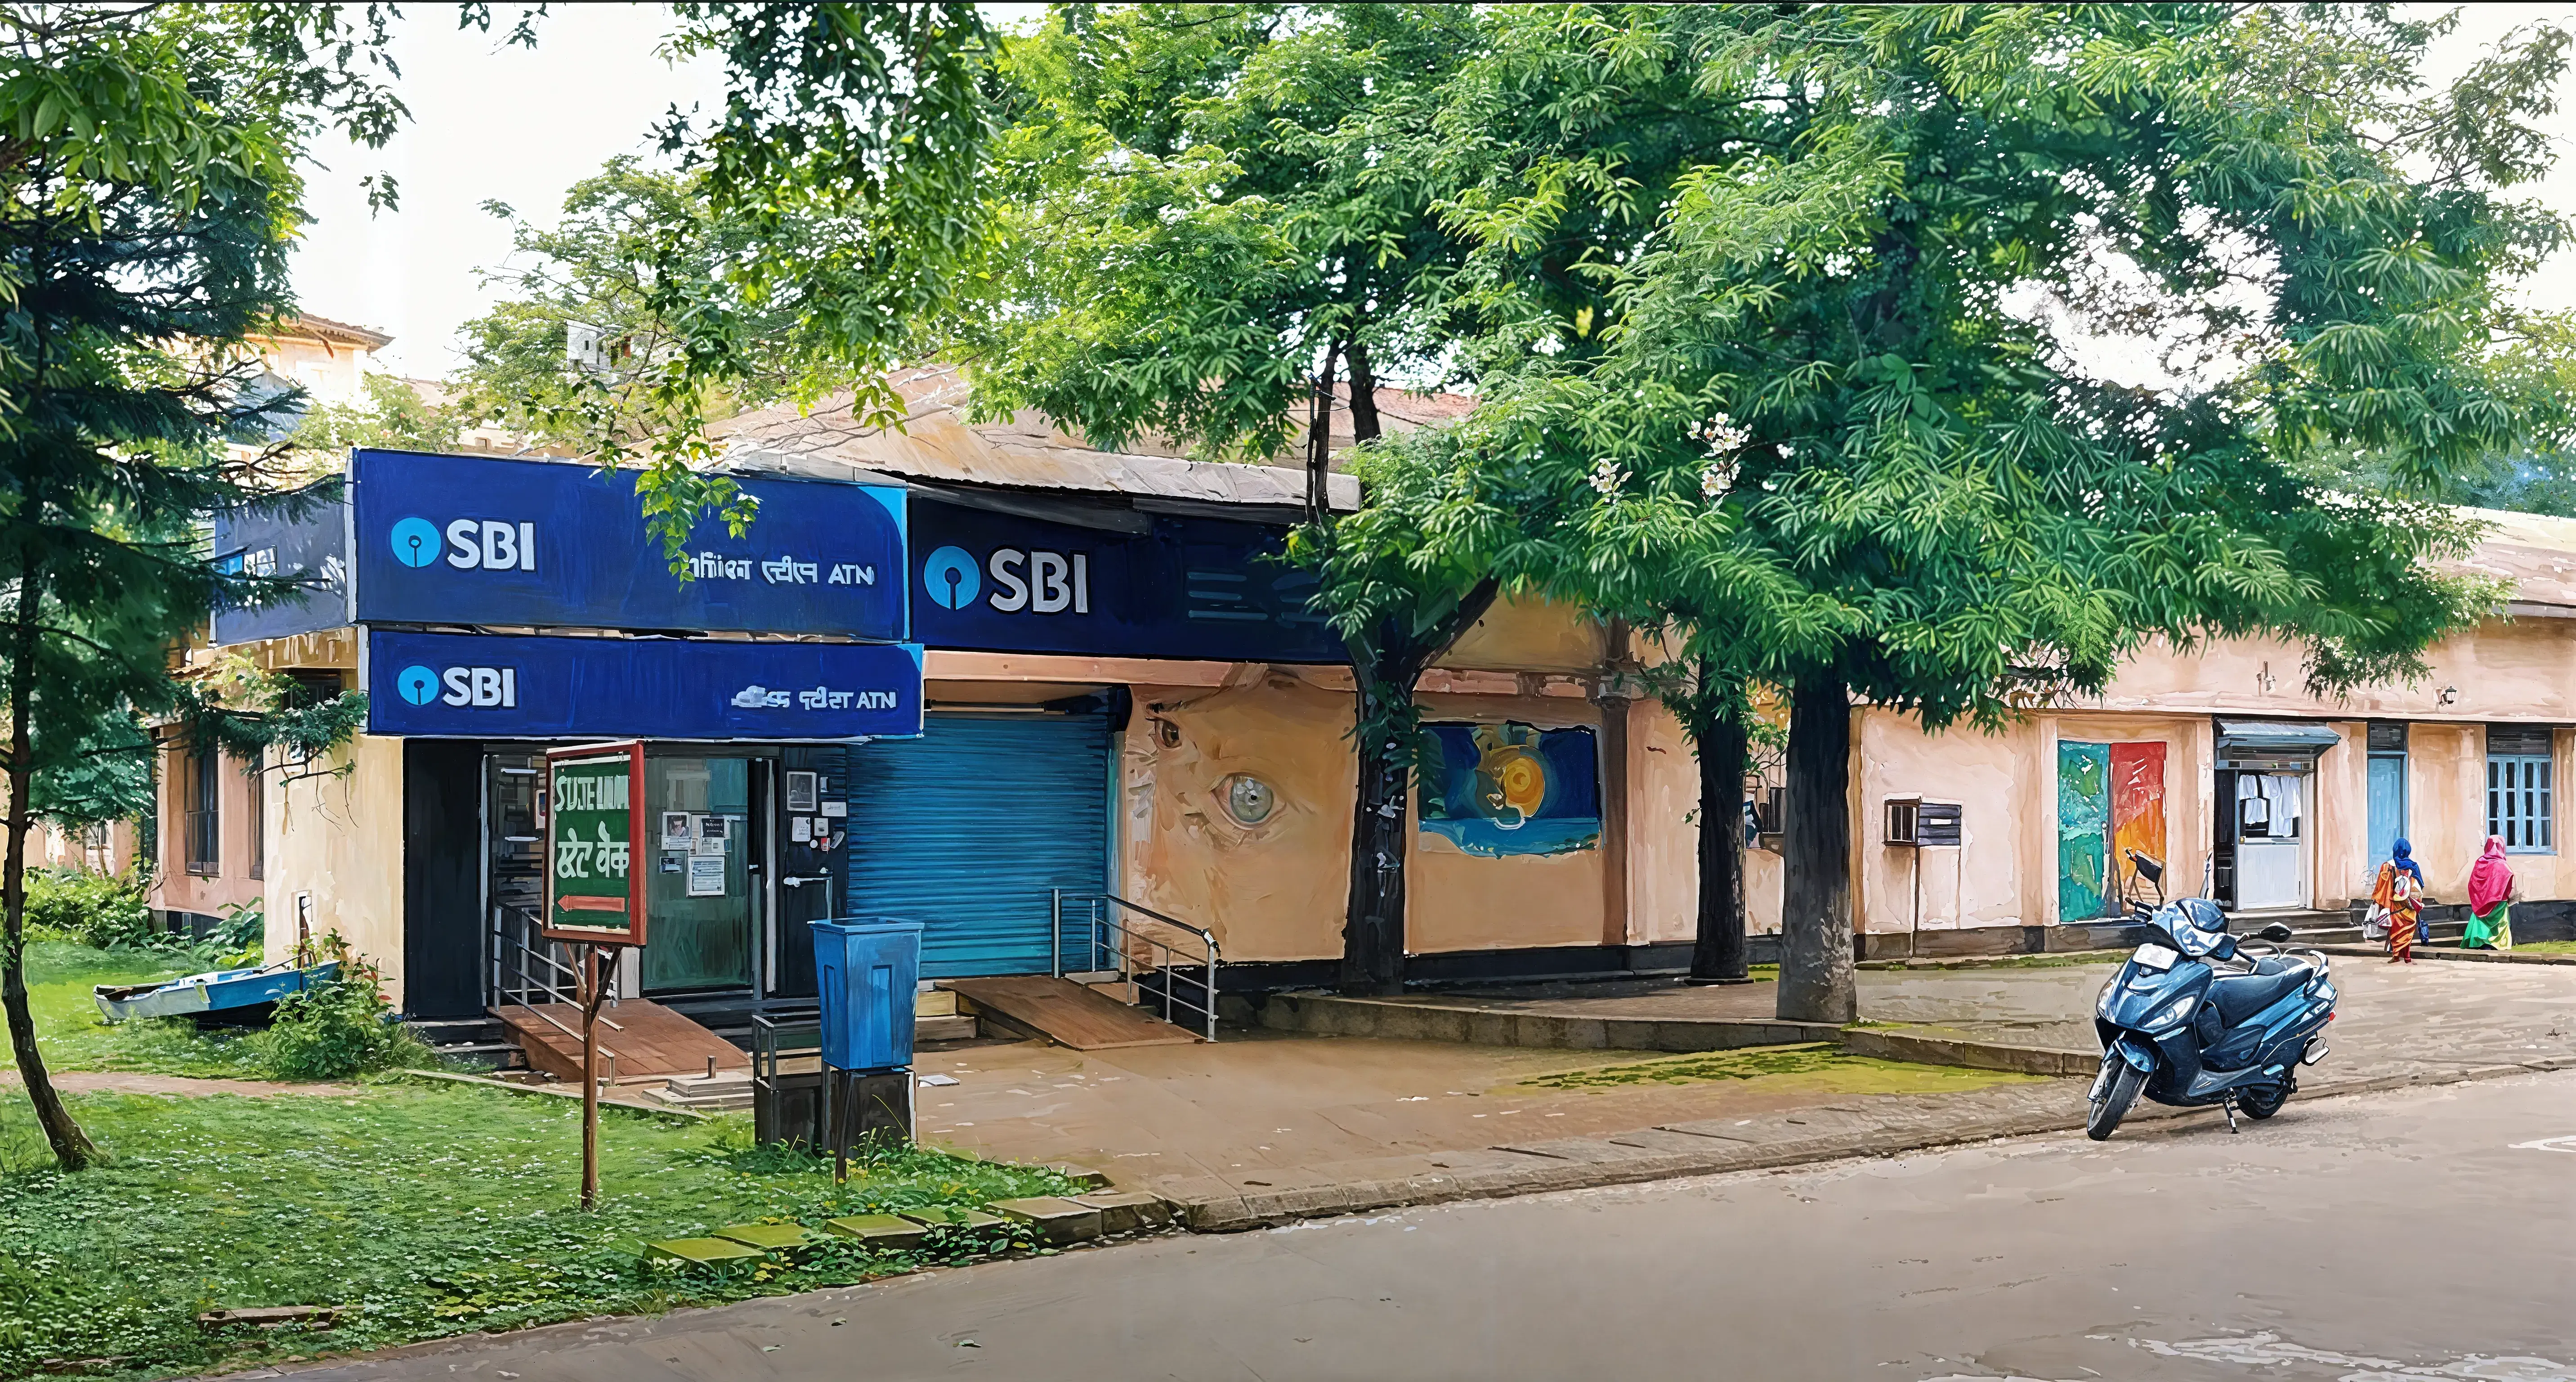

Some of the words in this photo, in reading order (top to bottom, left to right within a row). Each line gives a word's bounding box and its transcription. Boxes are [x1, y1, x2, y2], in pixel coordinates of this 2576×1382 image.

[447, 519, 535, 571] SBI
[989, 548, 1088, 613] SBI
[443, 667, 515, 707] SBI
